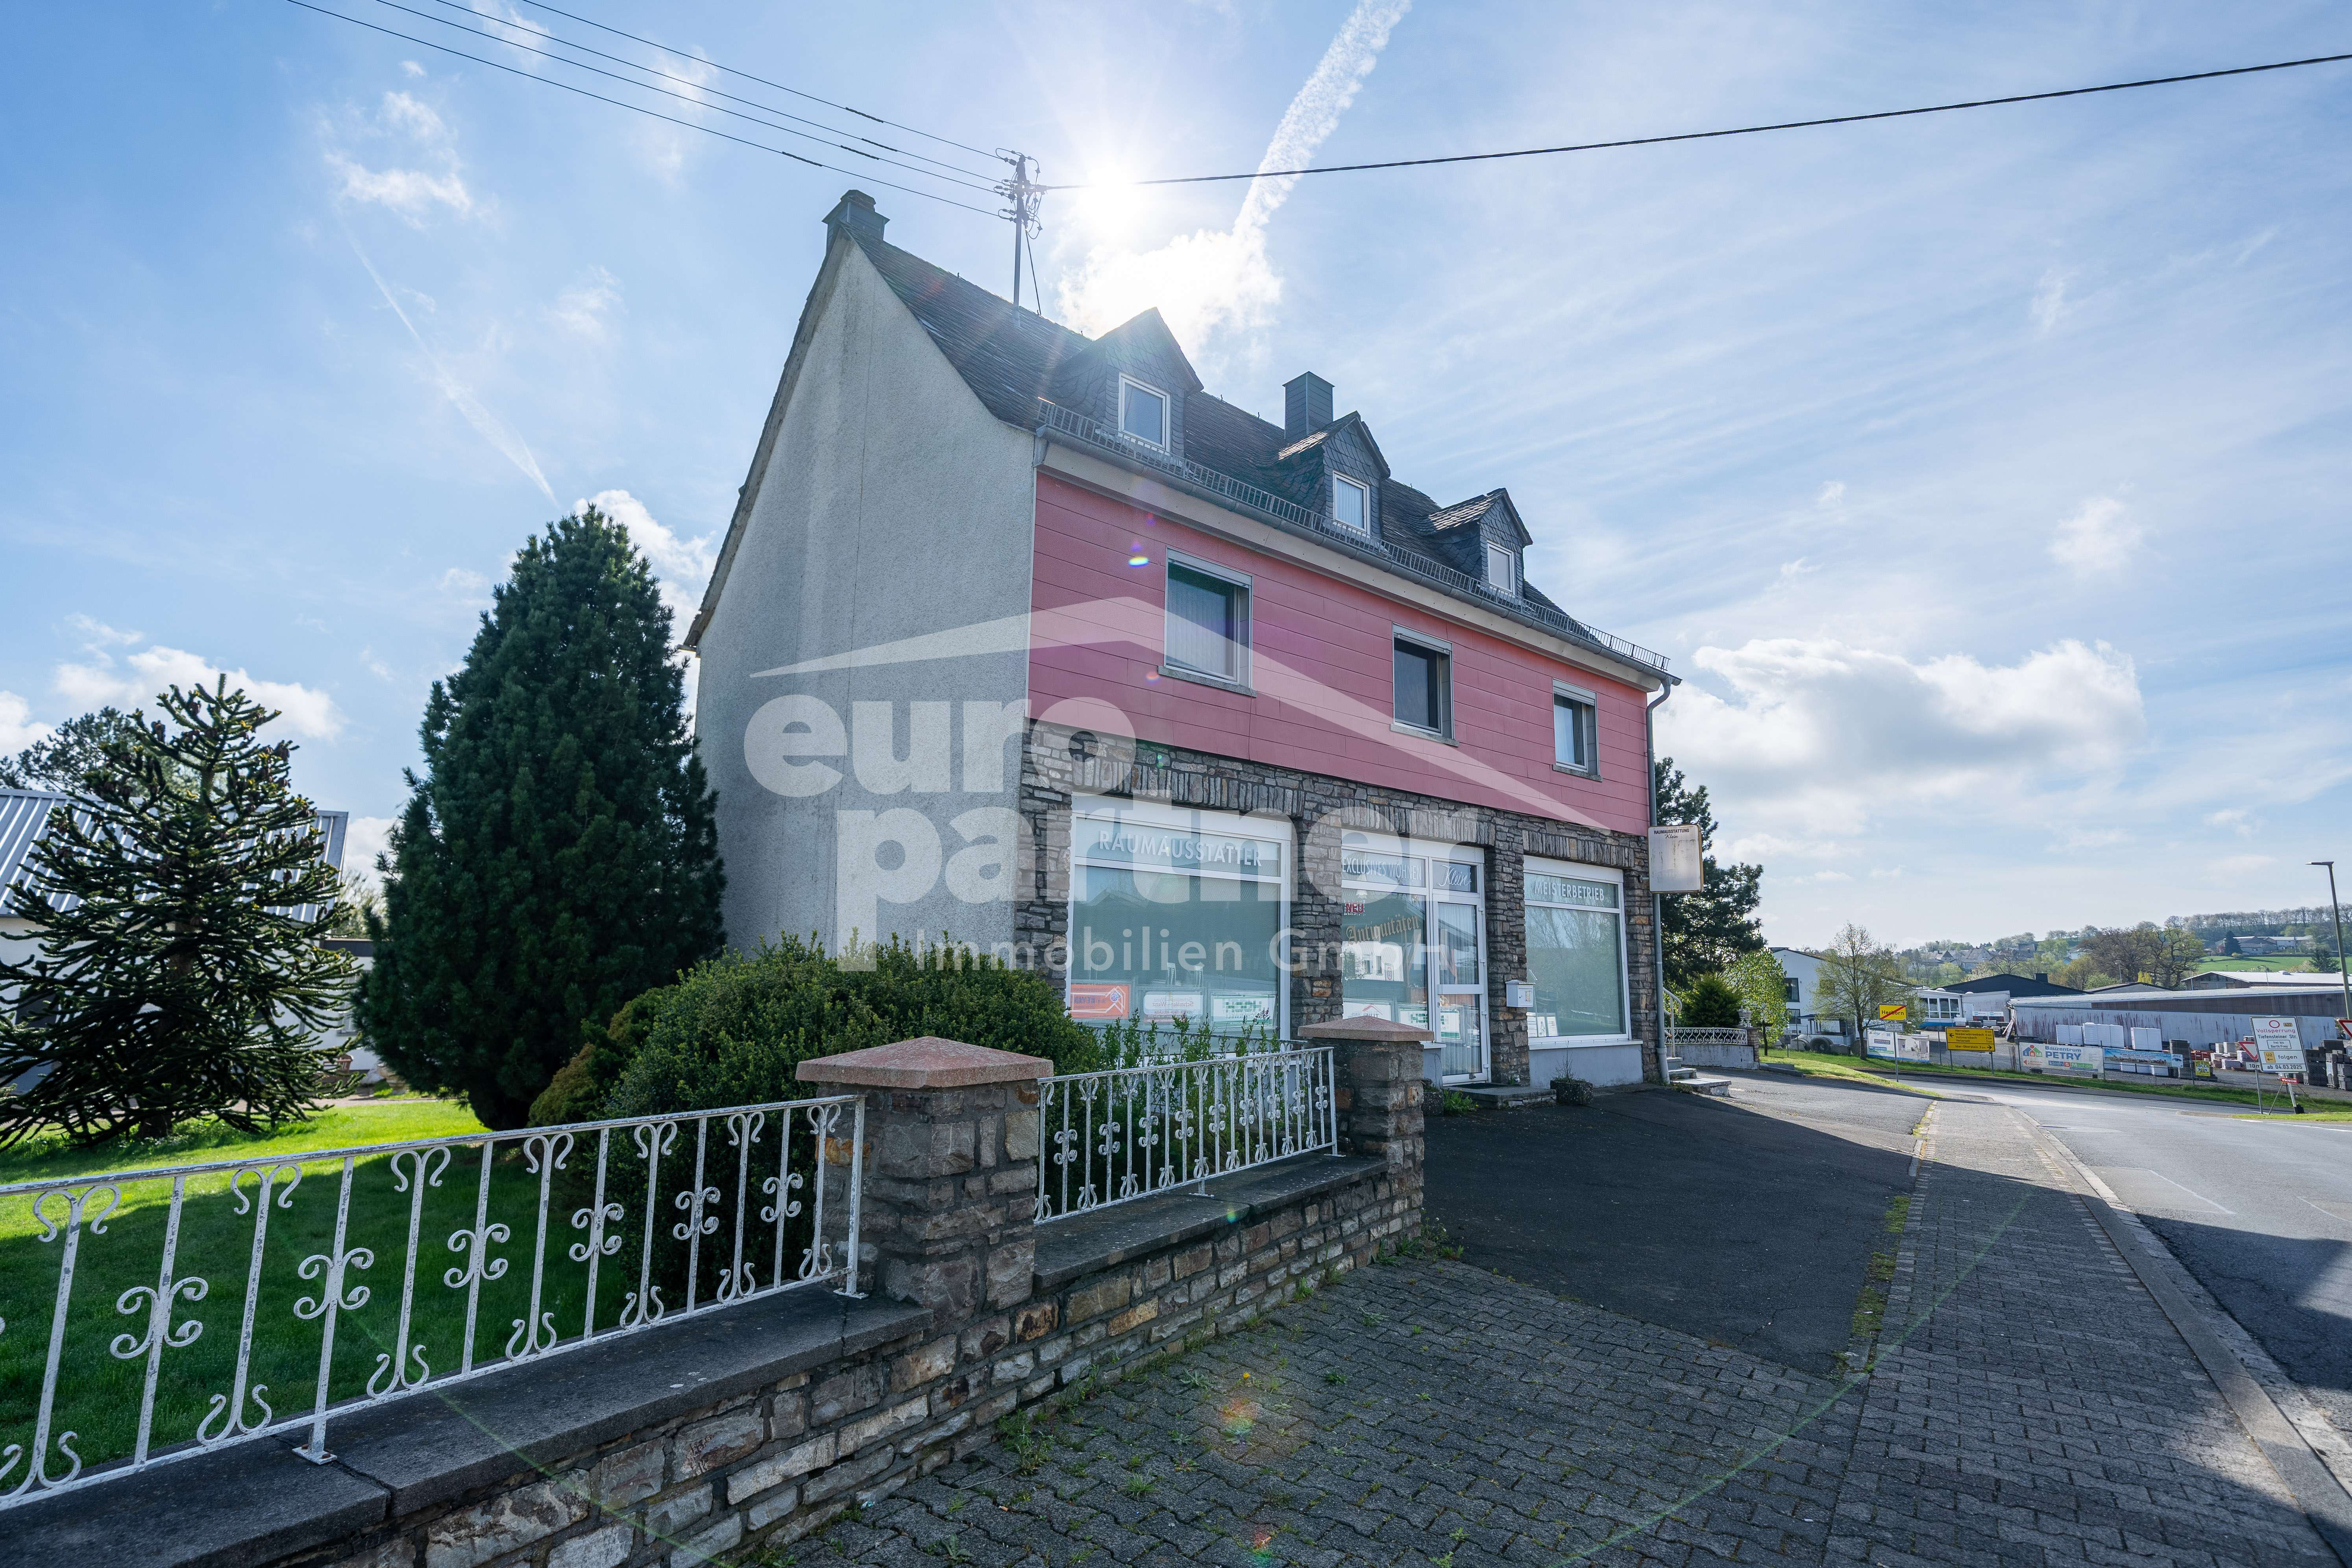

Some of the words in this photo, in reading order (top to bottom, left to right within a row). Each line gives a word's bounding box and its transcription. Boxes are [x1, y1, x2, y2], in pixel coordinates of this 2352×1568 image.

[1099, 830, 1262, 867] RAUMAUSSTATTER
[1342, 857, 1386, 876] EXCLUSIVES
[1389, 863, 1422, 880] WOHNEN
[1438, 865, 1471, 887] Klein
[1535, 881, 1604, 901] MEISTERBETRIEB
[1346, 902, 1364, 913] NEU
[1346, 913, 1420, 945] Antiquitäten
[2045, 1051, 2081, 1060] PETRY
